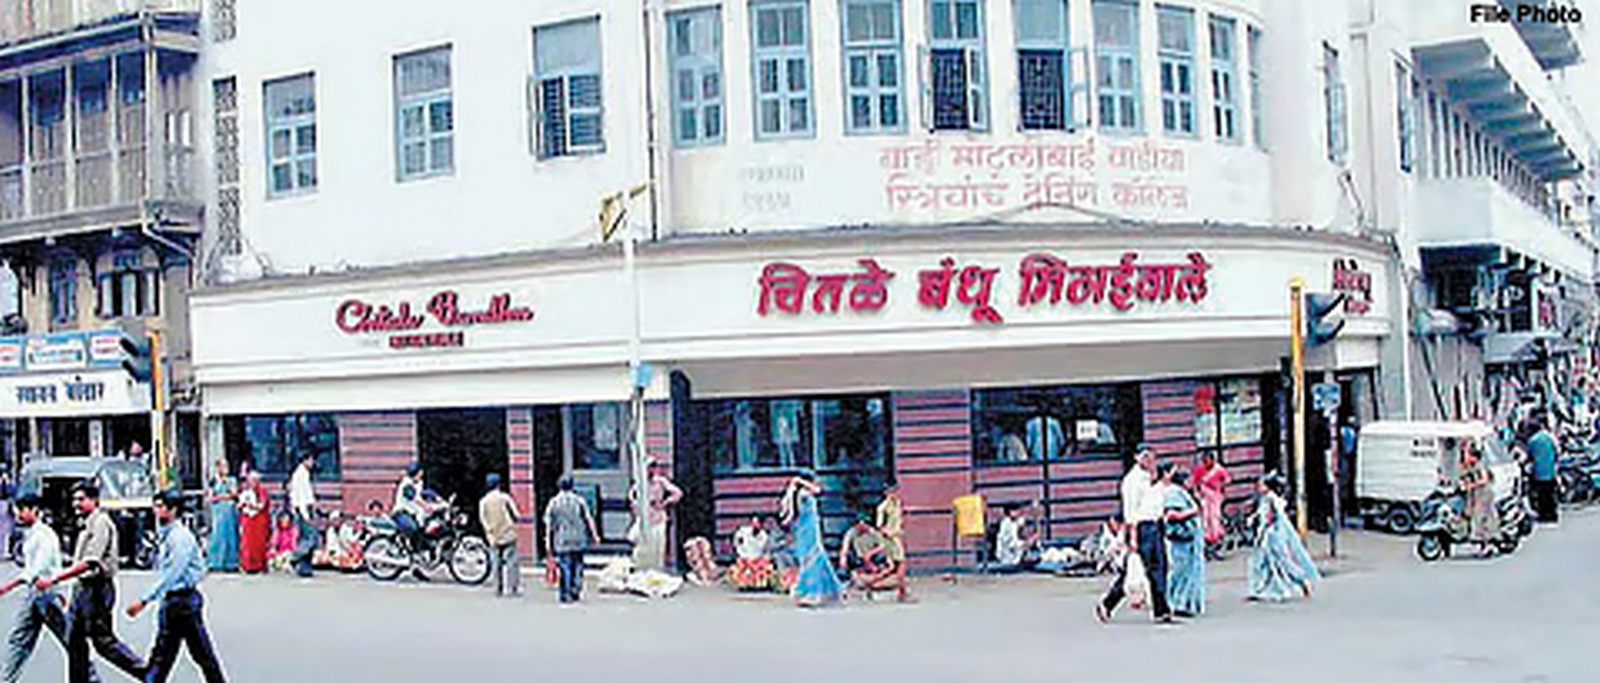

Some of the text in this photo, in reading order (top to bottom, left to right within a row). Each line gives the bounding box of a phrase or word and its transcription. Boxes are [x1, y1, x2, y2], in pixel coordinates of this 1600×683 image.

[757, 252, 1213, 324] चितळे बंधू मिठाईवाले
